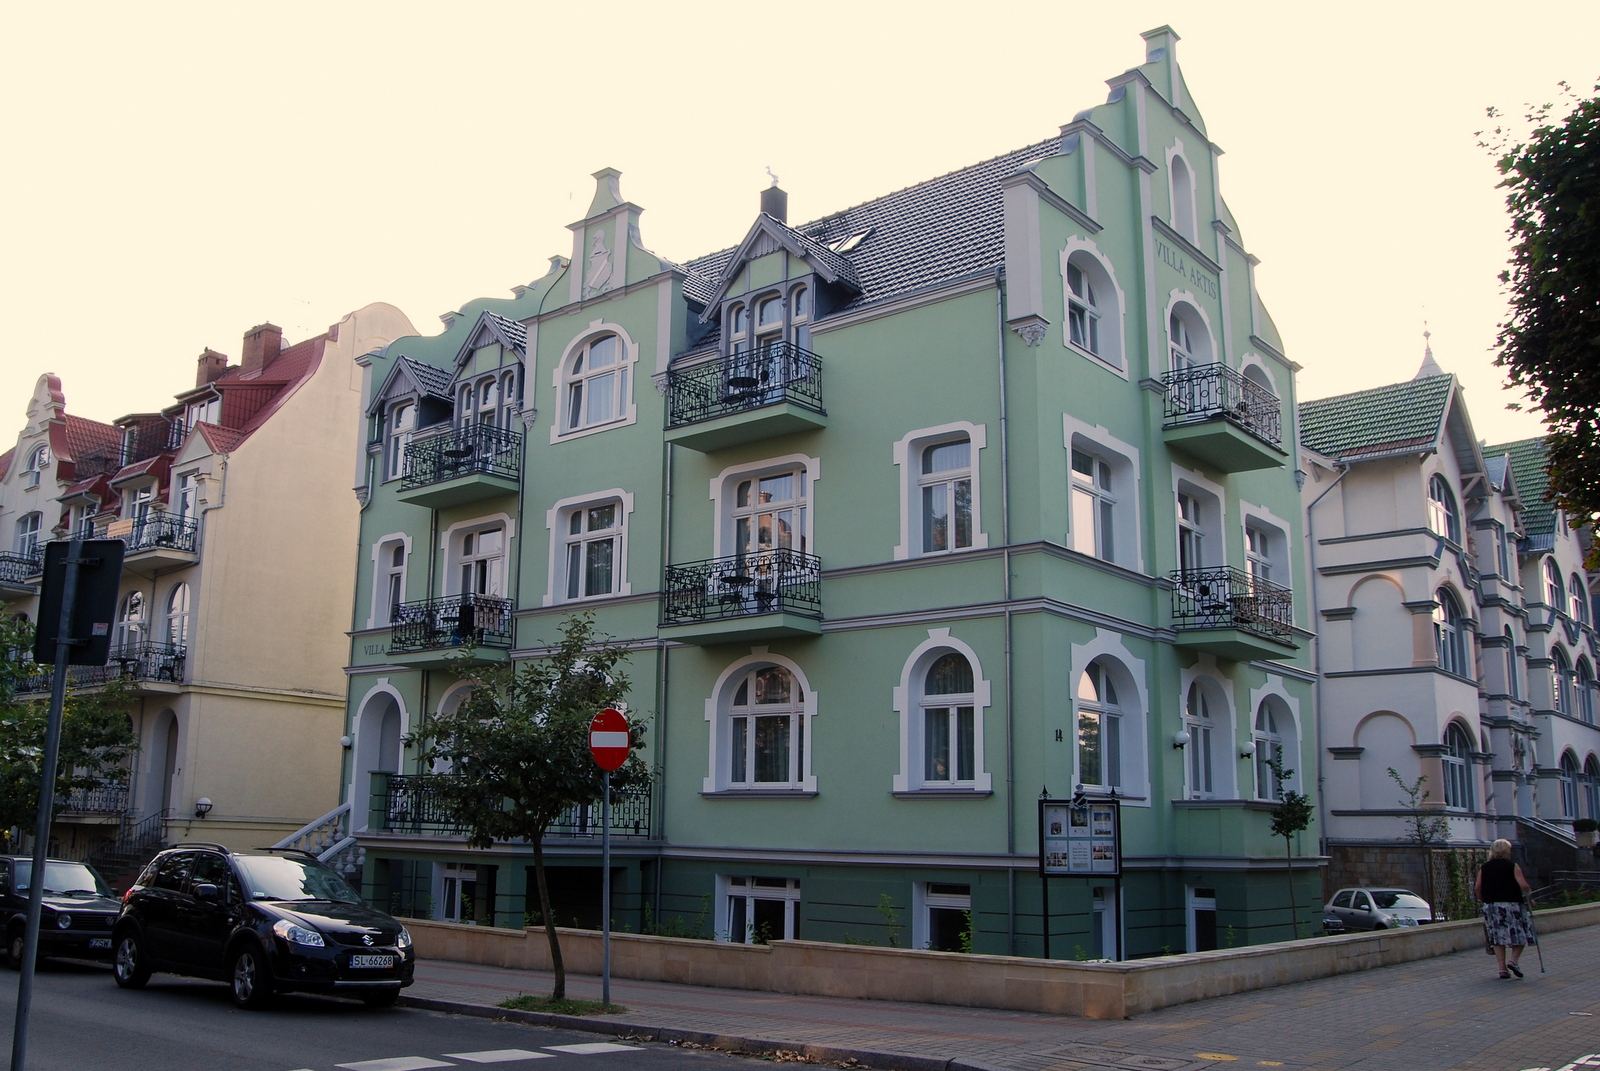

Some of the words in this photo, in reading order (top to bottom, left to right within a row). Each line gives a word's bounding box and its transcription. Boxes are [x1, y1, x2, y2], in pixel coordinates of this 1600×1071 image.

[1154, 239, 1186, 277] VILLA
[1190, 267, 1217, 300] ARTIS
[363, 643, 385, 656] VILLA
[354, 956, 366, 966] SL
[368, 956, 393, 966] 66268
